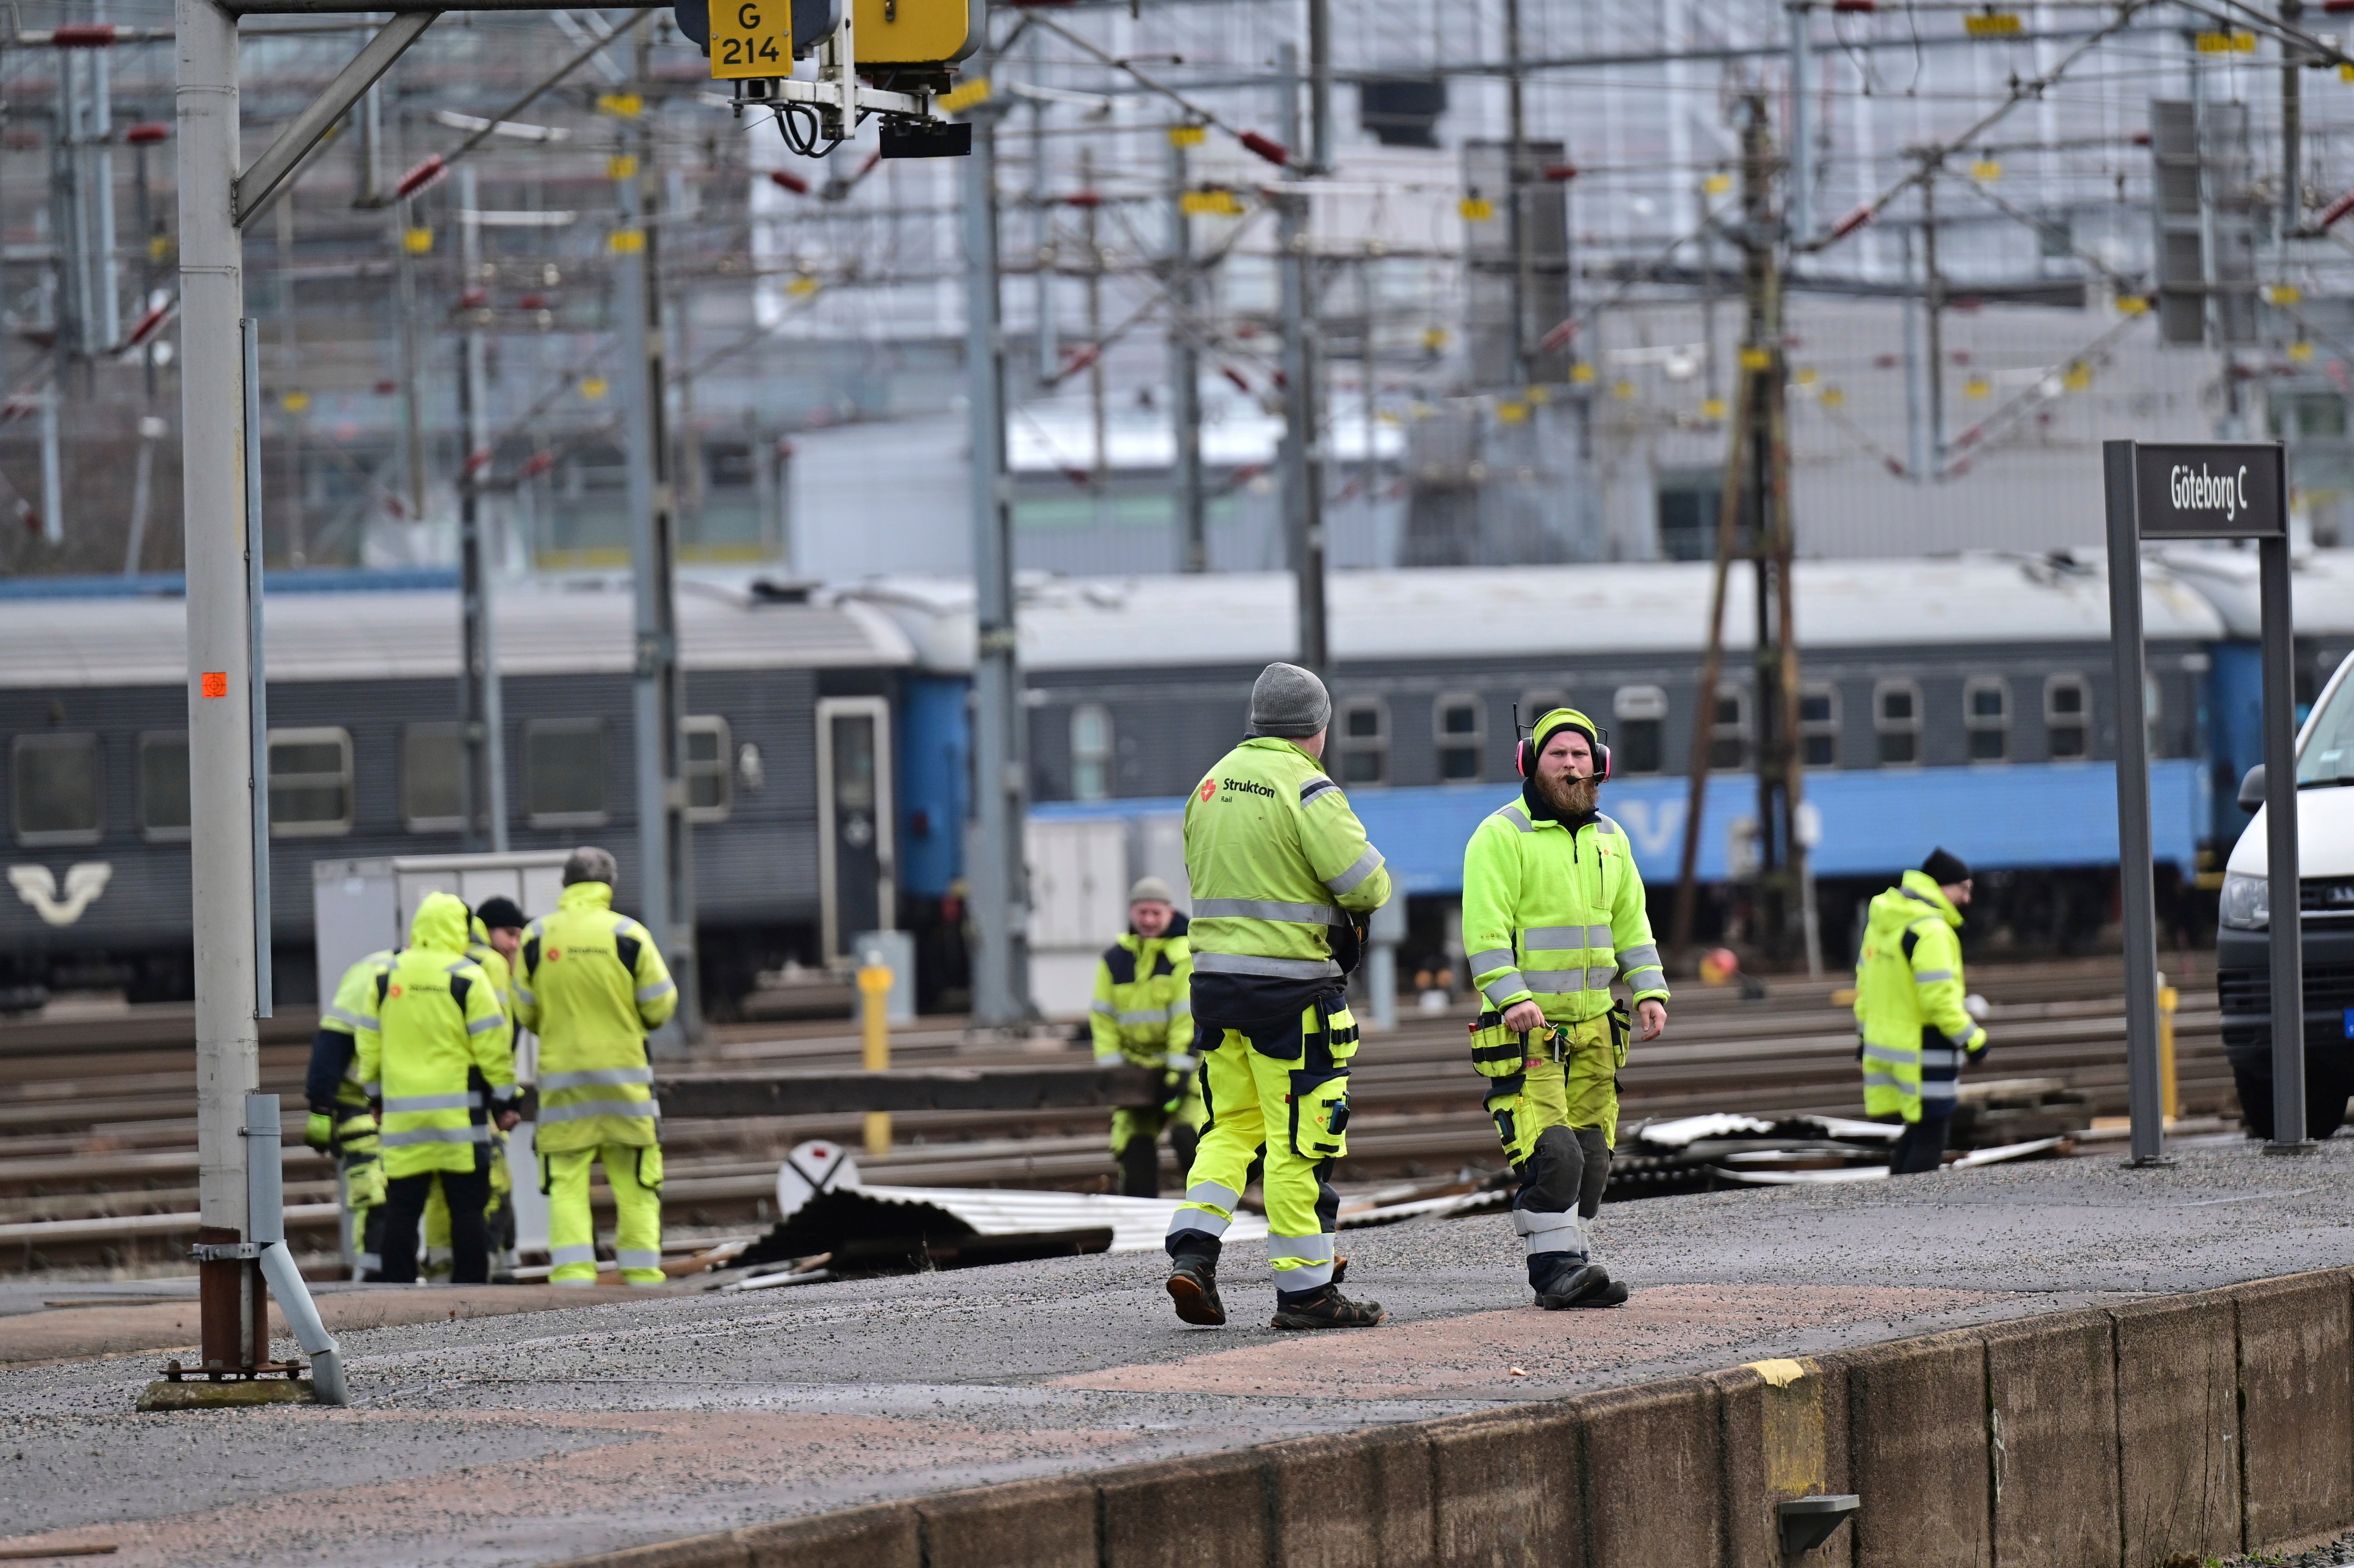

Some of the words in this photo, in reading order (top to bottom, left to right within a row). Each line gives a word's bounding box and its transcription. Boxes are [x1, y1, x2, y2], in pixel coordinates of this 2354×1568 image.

[739, 3, 761, 29] G
[723, 37, 779, 65] 214
[2171, 462, 2235, 521] Göteborg
[2238, 465, 2247, 509] C
[1222, 778, 1275, 798] Strukton
